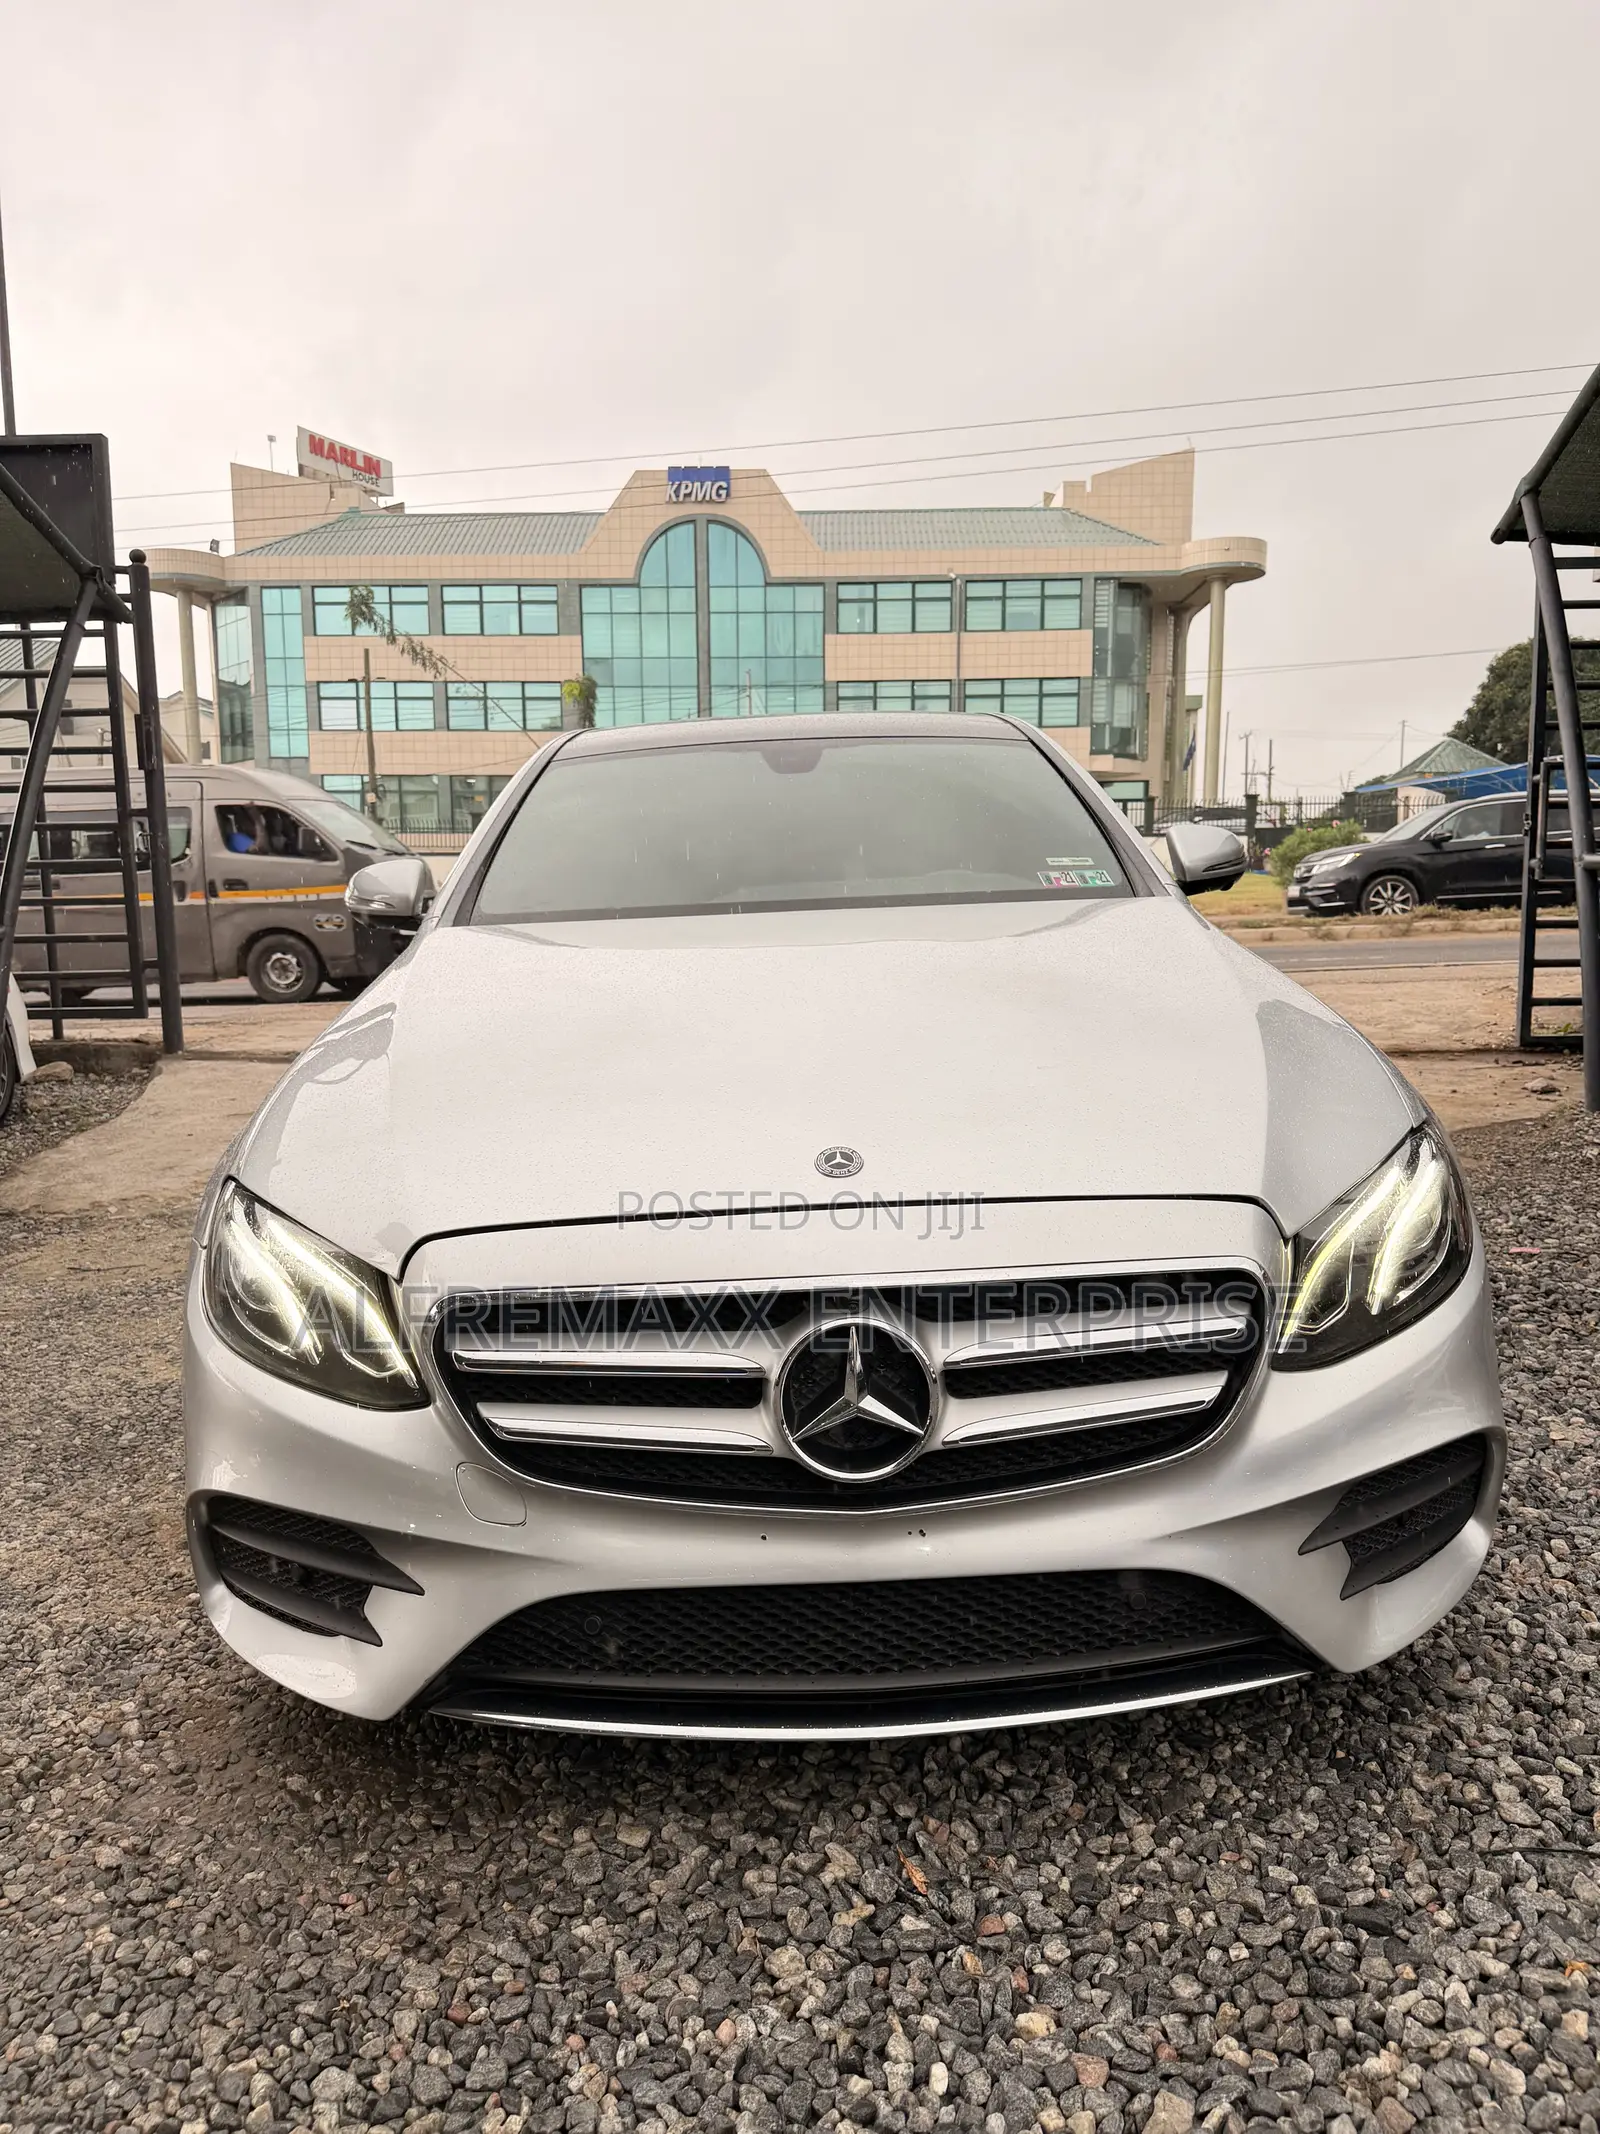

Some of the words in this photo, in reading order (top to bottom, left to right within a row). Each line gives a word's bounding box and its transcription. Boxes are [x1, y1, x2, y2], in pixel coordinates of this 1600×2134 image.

[309, 434, 381, 478] MARLIN
[352, 470, 380, 487] HOUSE
[666, 481, 728, 502] KPMG
